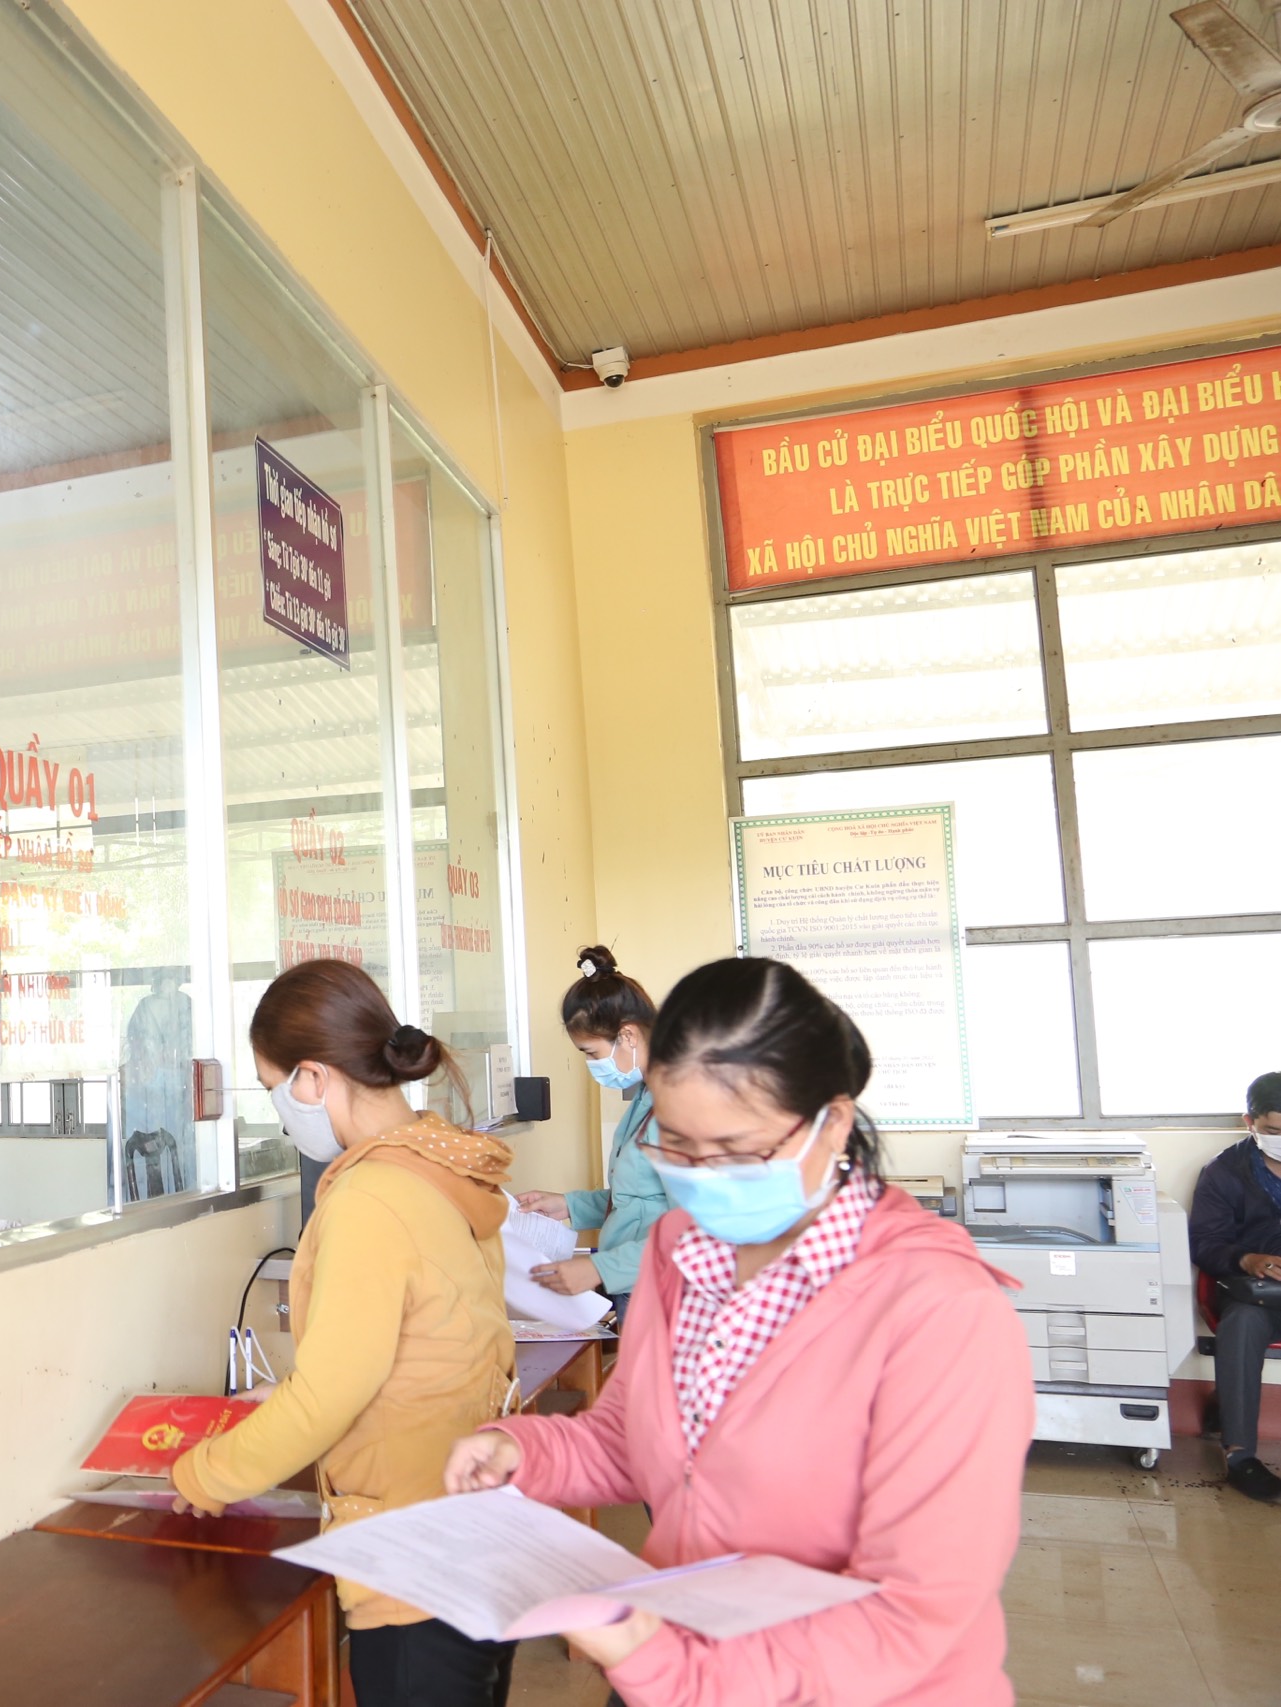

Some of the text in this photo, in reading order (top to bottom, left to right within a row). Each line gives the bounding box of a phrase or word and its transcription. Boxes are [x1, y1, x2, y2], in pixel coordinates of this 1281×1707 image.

[762, 436, 810, 477] BẦU
[817, 428, 849, 469] CỬ
[857, 430, 899, 467] ĐẠI
[905, 410, 963, 456] BIỂU
[970, 401, 1037, 449] QUỐC
[1044, 396, 1089, 438] HỘI
[1096, 388, 1133, 427] VÀ
[1142, 385, 1190, 424] ĐẠI
[1196, 363, 1263, 412] BIỂU
[830, 424, 1279, 515] LÀ TRỰC TIẾP GÓP PHẦN XÂY DỰNG
[747, 471, 1281, 577] XÃ HỘI CHỦ NGHĨA VIỆT NAM CỦA NHÂN DÂ
[68, 767, 99, 822] 01
[291, 808, 346, 866] QUẦY 02
[447, 854, 480, 899] QUẦY 03
[763, 856, 926, 880] MỤC TIÊU CHẤT LƯỢNG
